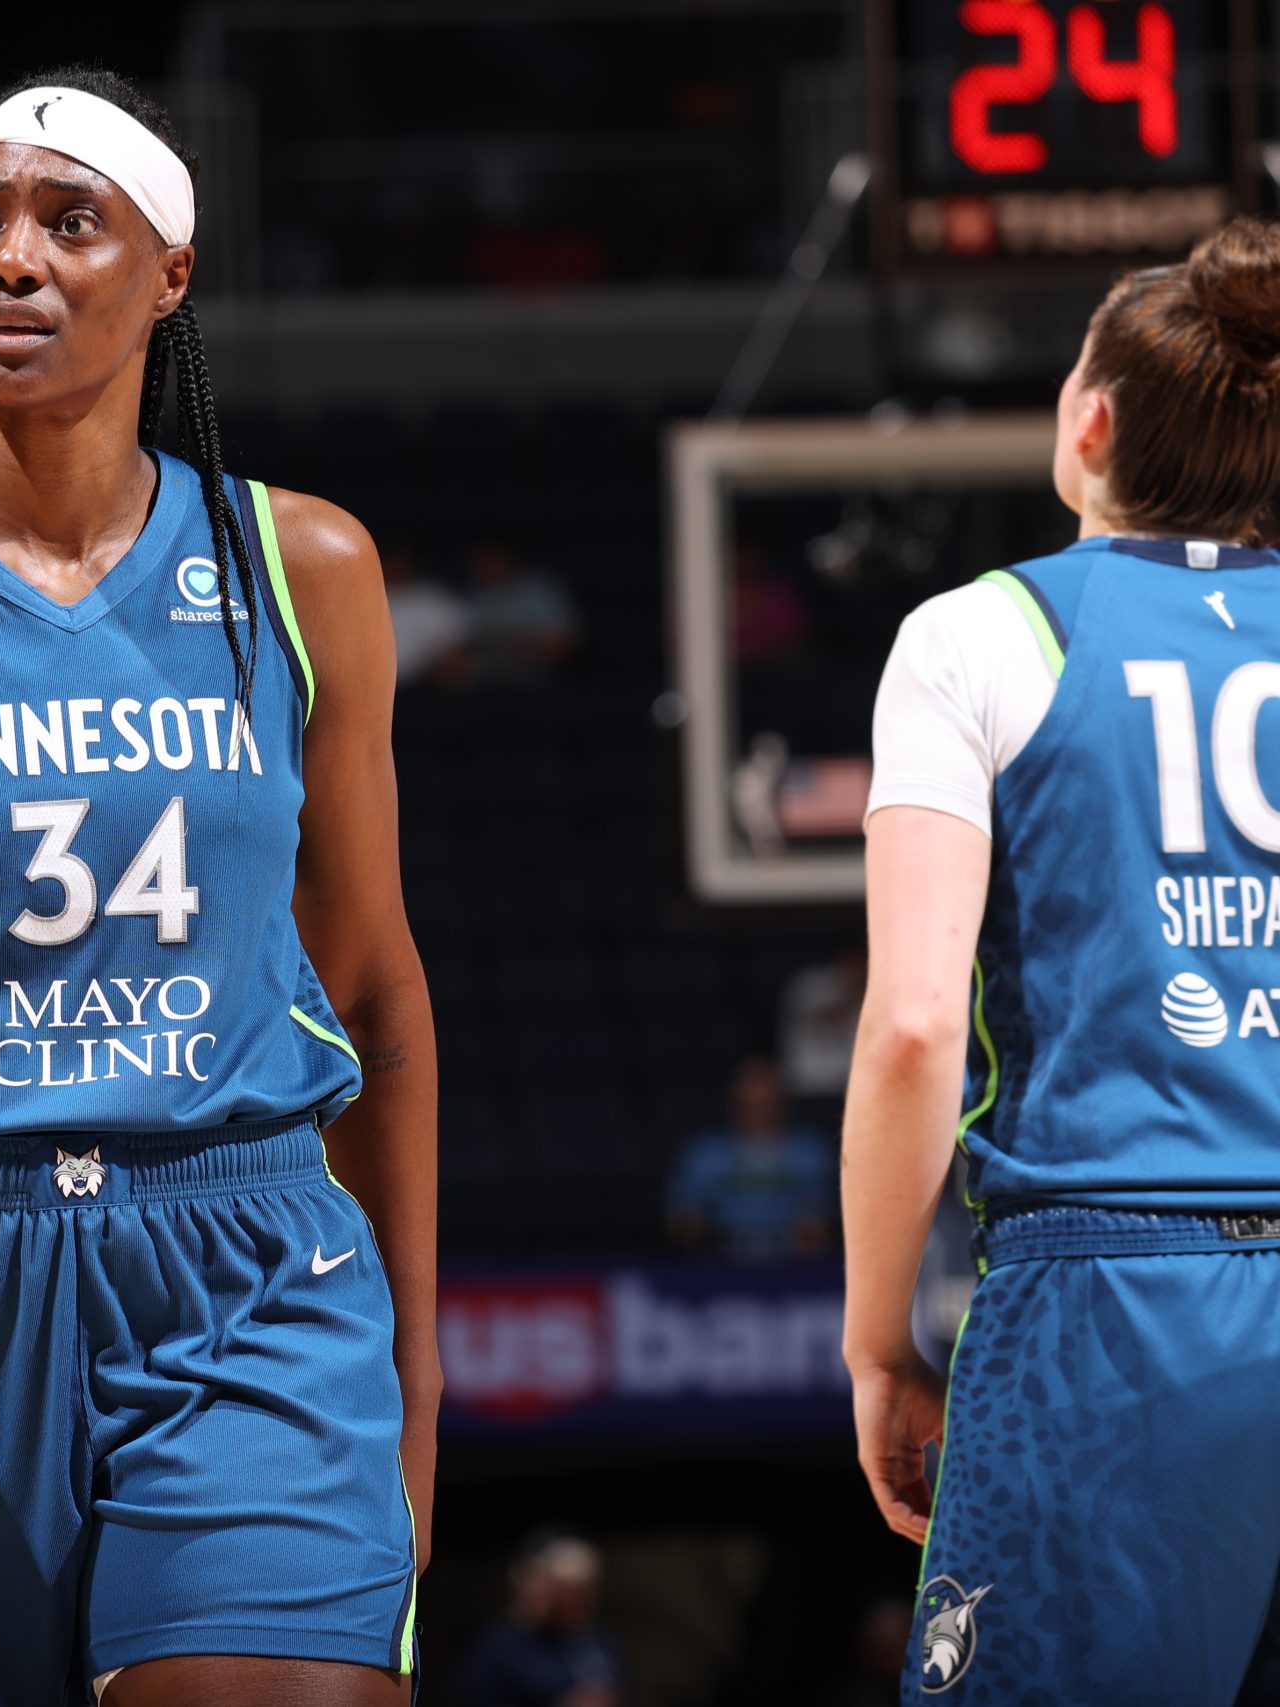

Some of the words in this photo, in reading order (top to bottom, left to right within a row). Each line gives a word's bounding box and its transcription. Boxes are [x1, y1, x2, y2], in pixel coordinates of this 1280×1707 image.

[949, 0, 1179, 175] 24
[170, 607, 249, 622] sharecre
[1122, 659, 1280, 854] 10
[8, 796, 199, 946] 34
[4, 975, 211, 1029] MAYO
